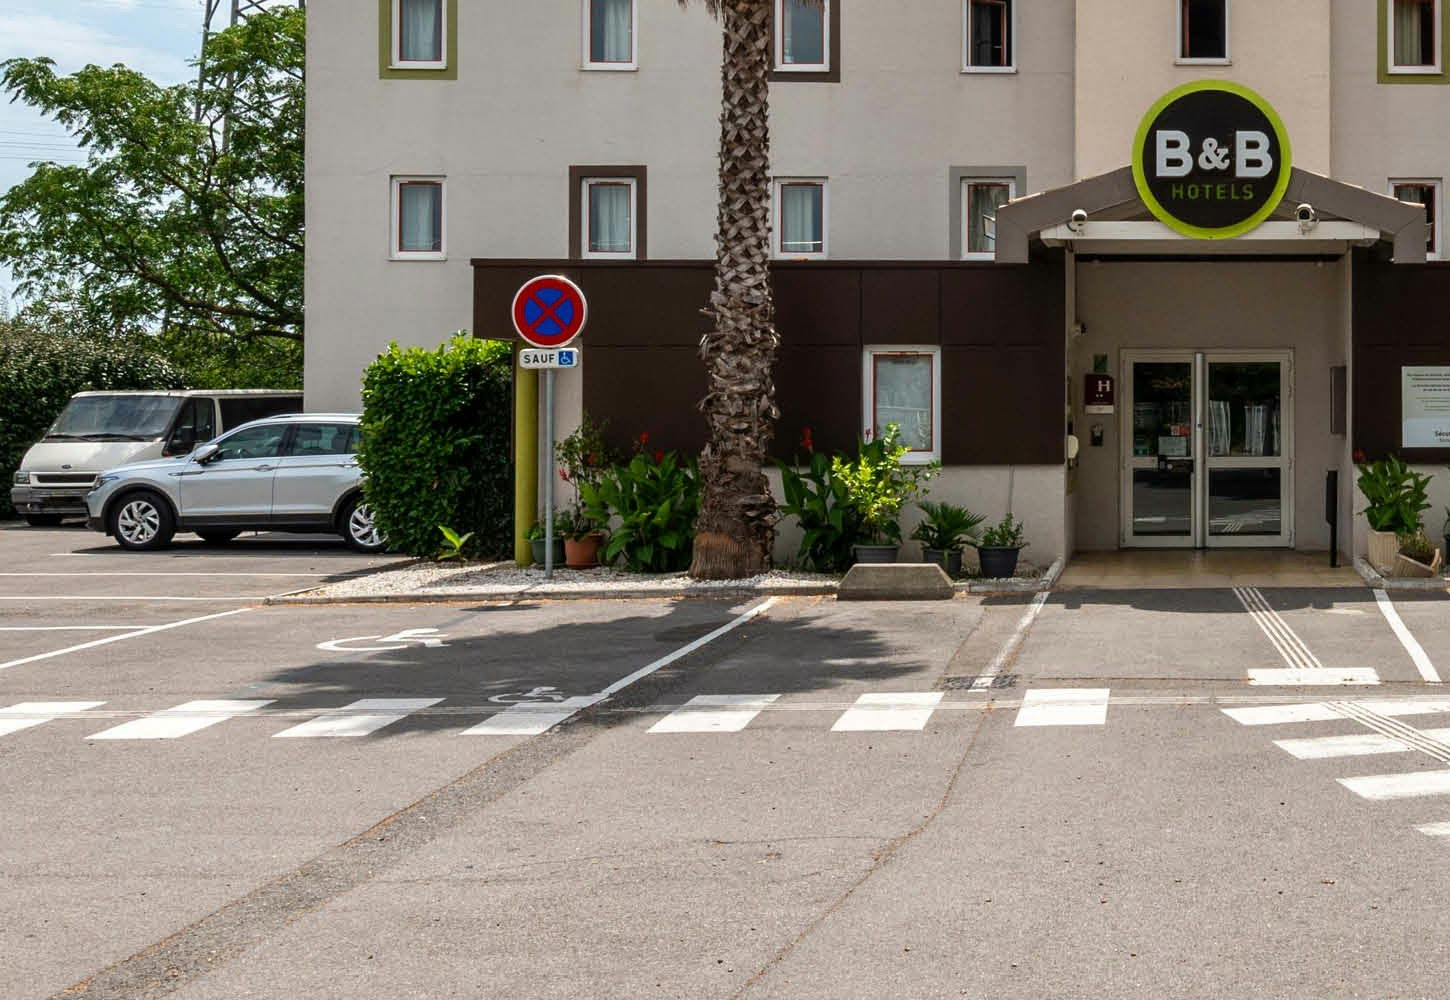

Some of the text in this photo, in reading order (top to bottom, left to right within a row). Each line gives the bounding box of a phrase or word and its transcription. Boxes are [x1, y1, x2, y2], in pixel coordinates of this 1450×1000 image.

[1155, 129, 1273, 179] B&B
[1171, 183, 1254, 200] HOTELS
[523, 353, 555, 364] SAUF
